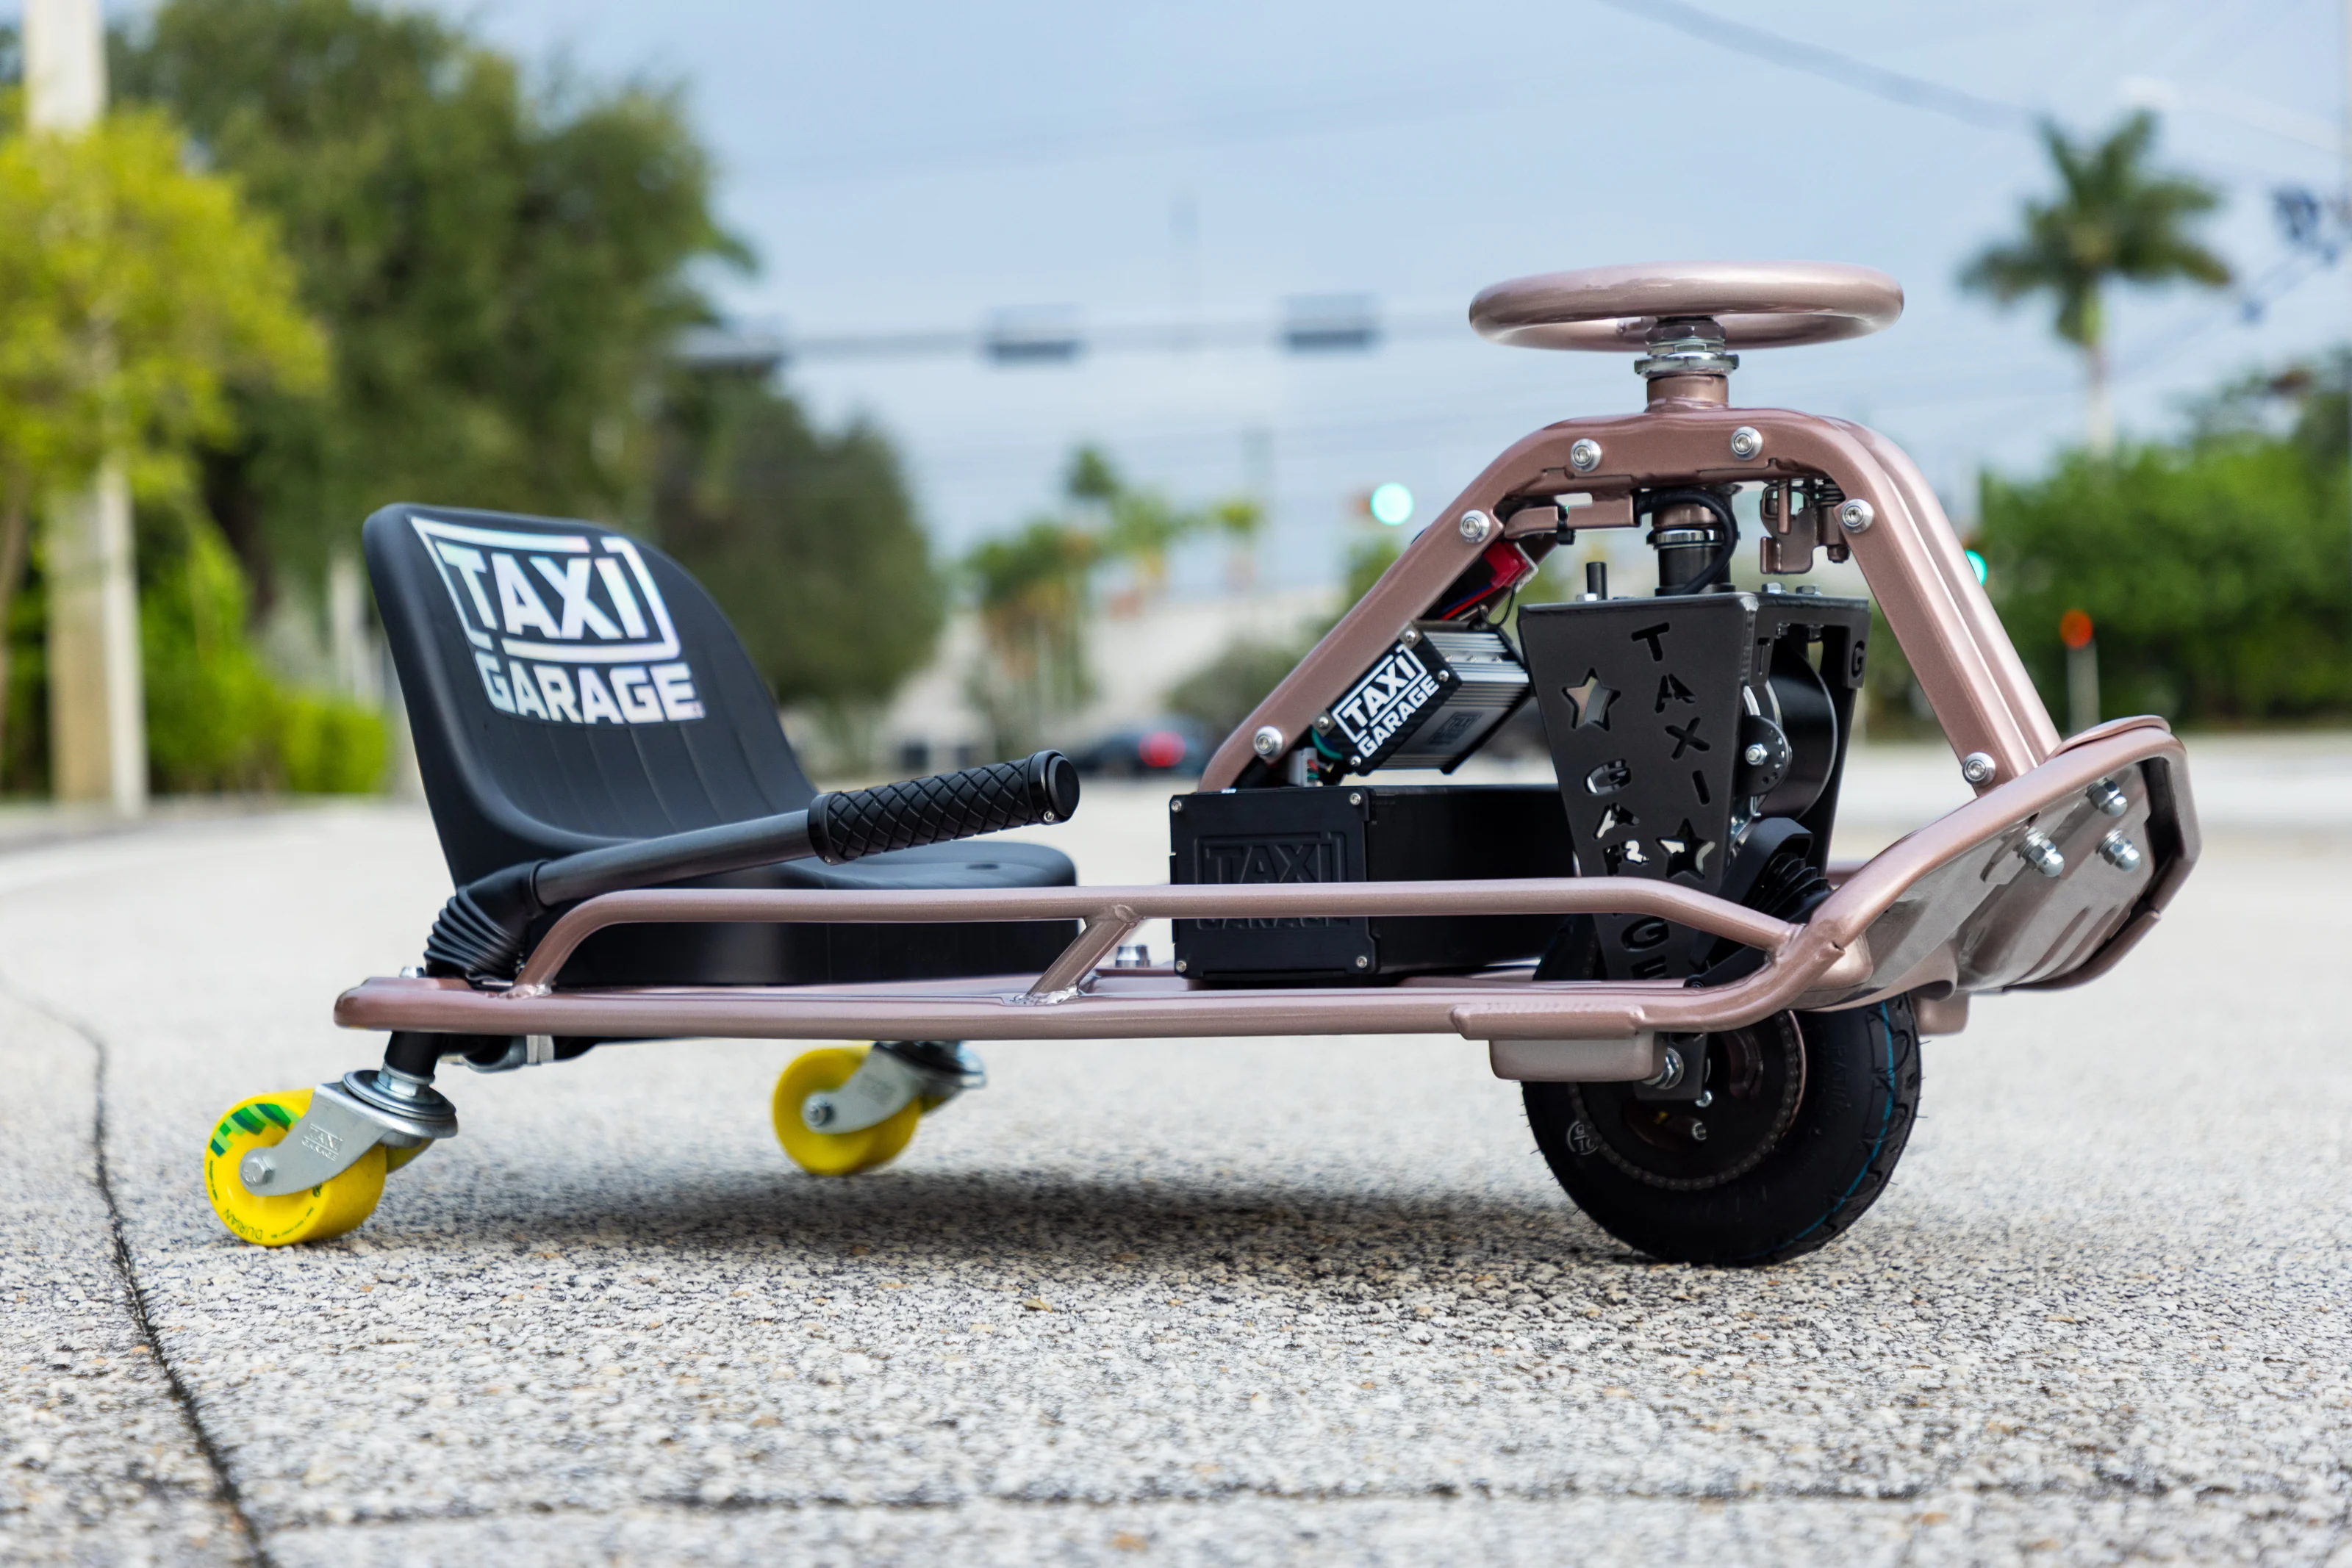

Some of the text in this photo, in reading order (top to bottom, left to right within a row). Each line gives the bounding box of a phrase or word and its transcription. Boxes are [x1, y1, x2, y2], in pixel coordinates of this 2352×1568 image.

[435, 540, 648, 640] TAXI
[474, 650, 706, 724] GARAGE
[1341, 655, 1417, 728] TAXI
[1357, 675, 1440, 758] GARAGE
[1205, 842, 1334, 884] TAXI
[223, 1209, 264, 1240] DURIAN
